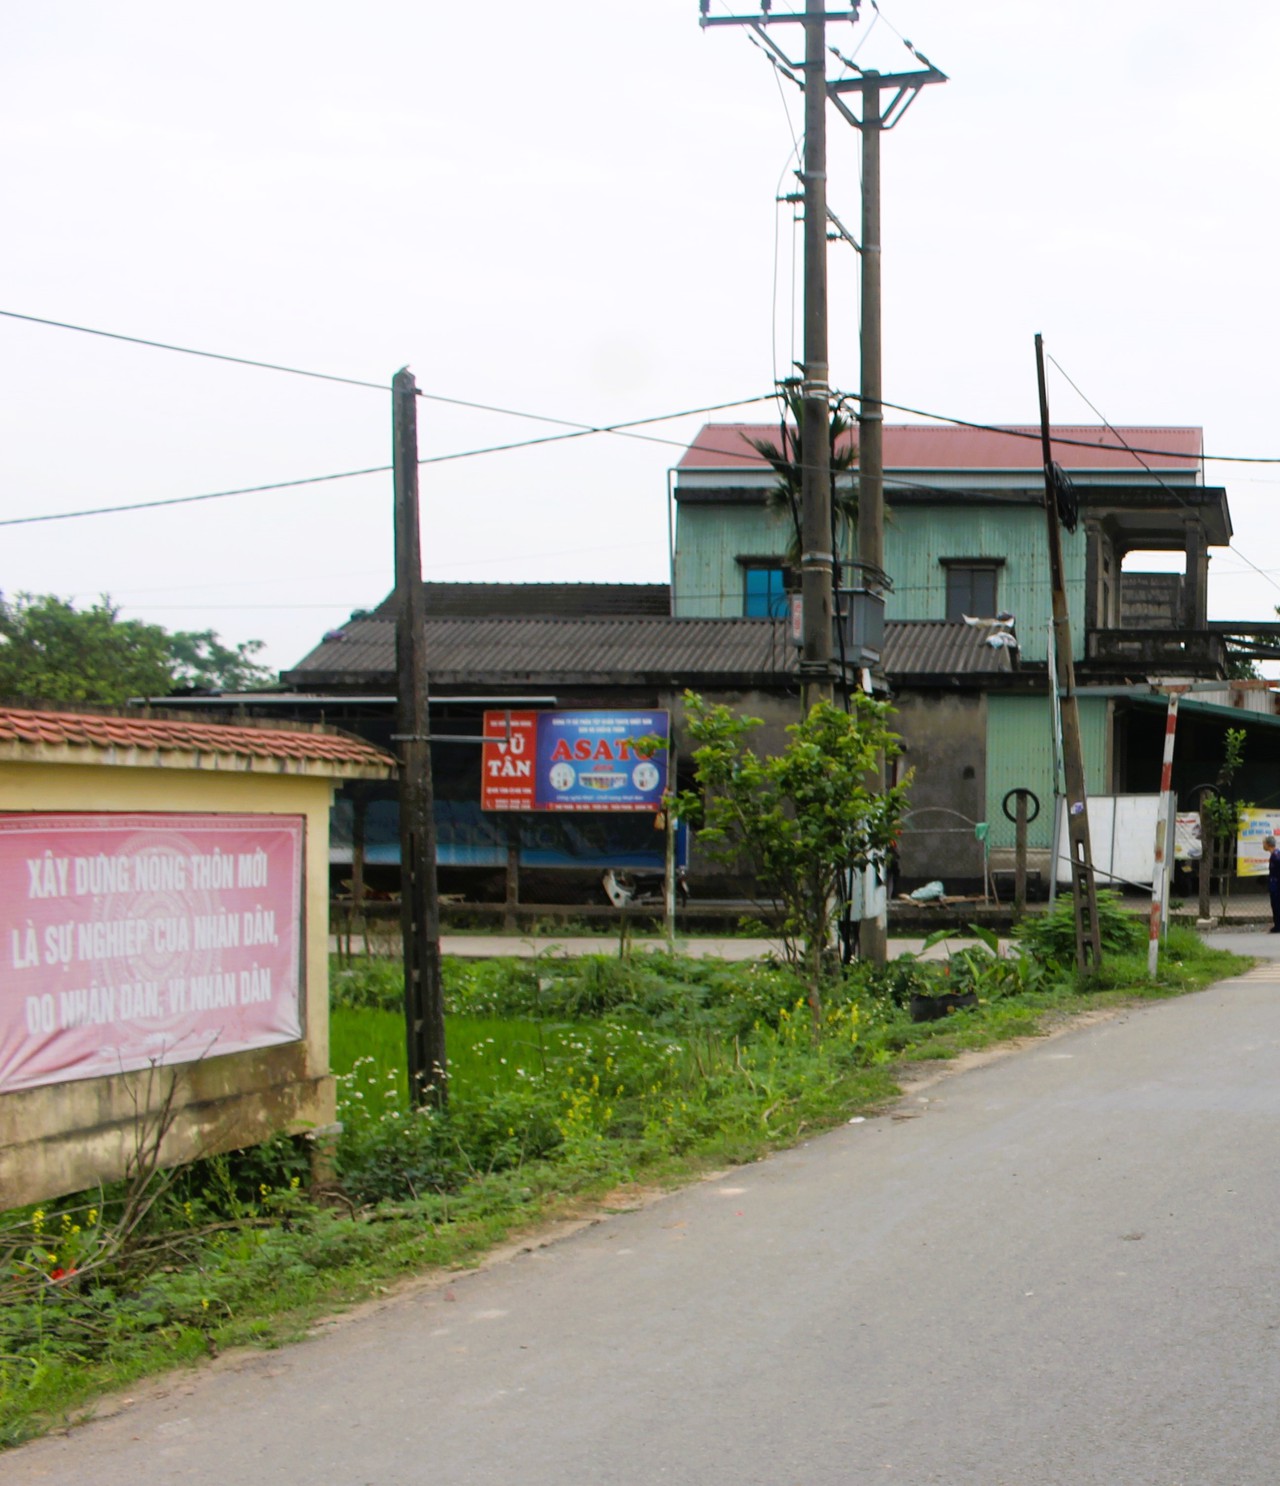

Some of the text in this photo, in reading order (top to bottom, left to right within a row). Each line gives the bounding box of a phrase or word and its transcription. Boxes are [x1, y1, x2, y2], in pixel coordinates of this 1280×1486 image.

[487, 755, 532, 777] TÂN
[497, 734, 526, 754] VŨ
[27, 846, 269, 903] XÂY DỰNG NÔNG THÔN MỚI
[12, 919, 40, 970] LÀ
[45, 920, 75, 973] SỰ
[194, 906, 240, 952] NHÂN
[243, 903, 279, 948] DÂN,
[26, 992, 57, 1035] DO
[61, 980, 115, 1030] NHÂN
[191, 965, 236, 1012] NHÂN
[239, 961, 272, 1006] DÂN
